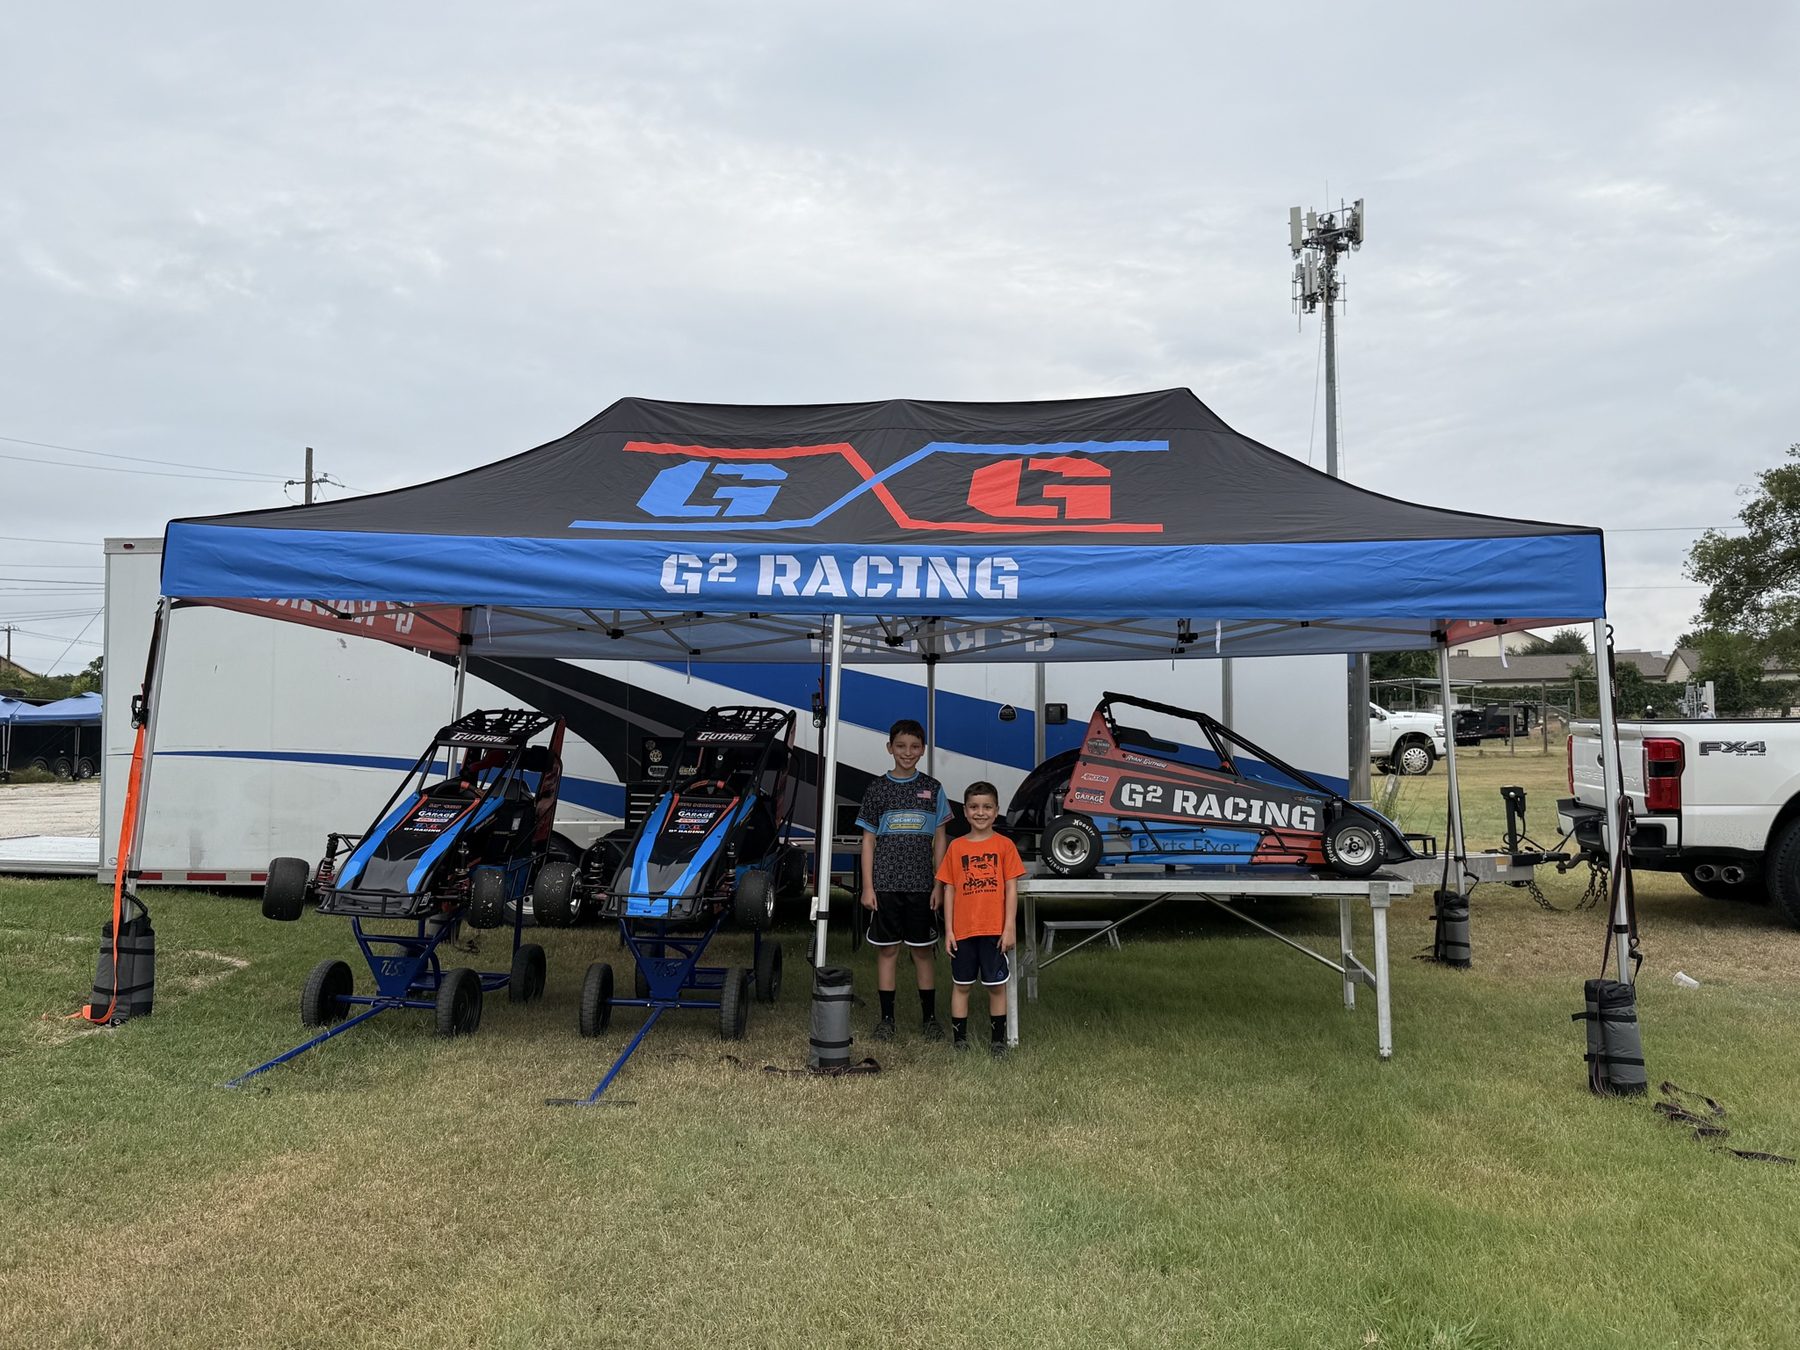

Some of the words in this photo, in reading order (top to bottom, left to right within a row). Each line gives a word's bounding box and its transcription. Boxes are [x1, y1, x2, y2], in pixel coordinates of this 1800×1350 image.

[757, 554, 1019, 600] RACING
[450, 732, 509, 743] GUTHRIE
[697, 731, 753, 742] GUTHRIE
[1699, 741, 1767, 756] FX4
[1075, 791, 1105, 804] GARAGE
[418, 811, 457, 819] GARAGE
[678, 811, 716, 819] GARAGE
[1172, 788, 1317, 831] RACING
[1138, 837, 1187, 852] Parts
[1194, 838, 1240, 853] Fixer
